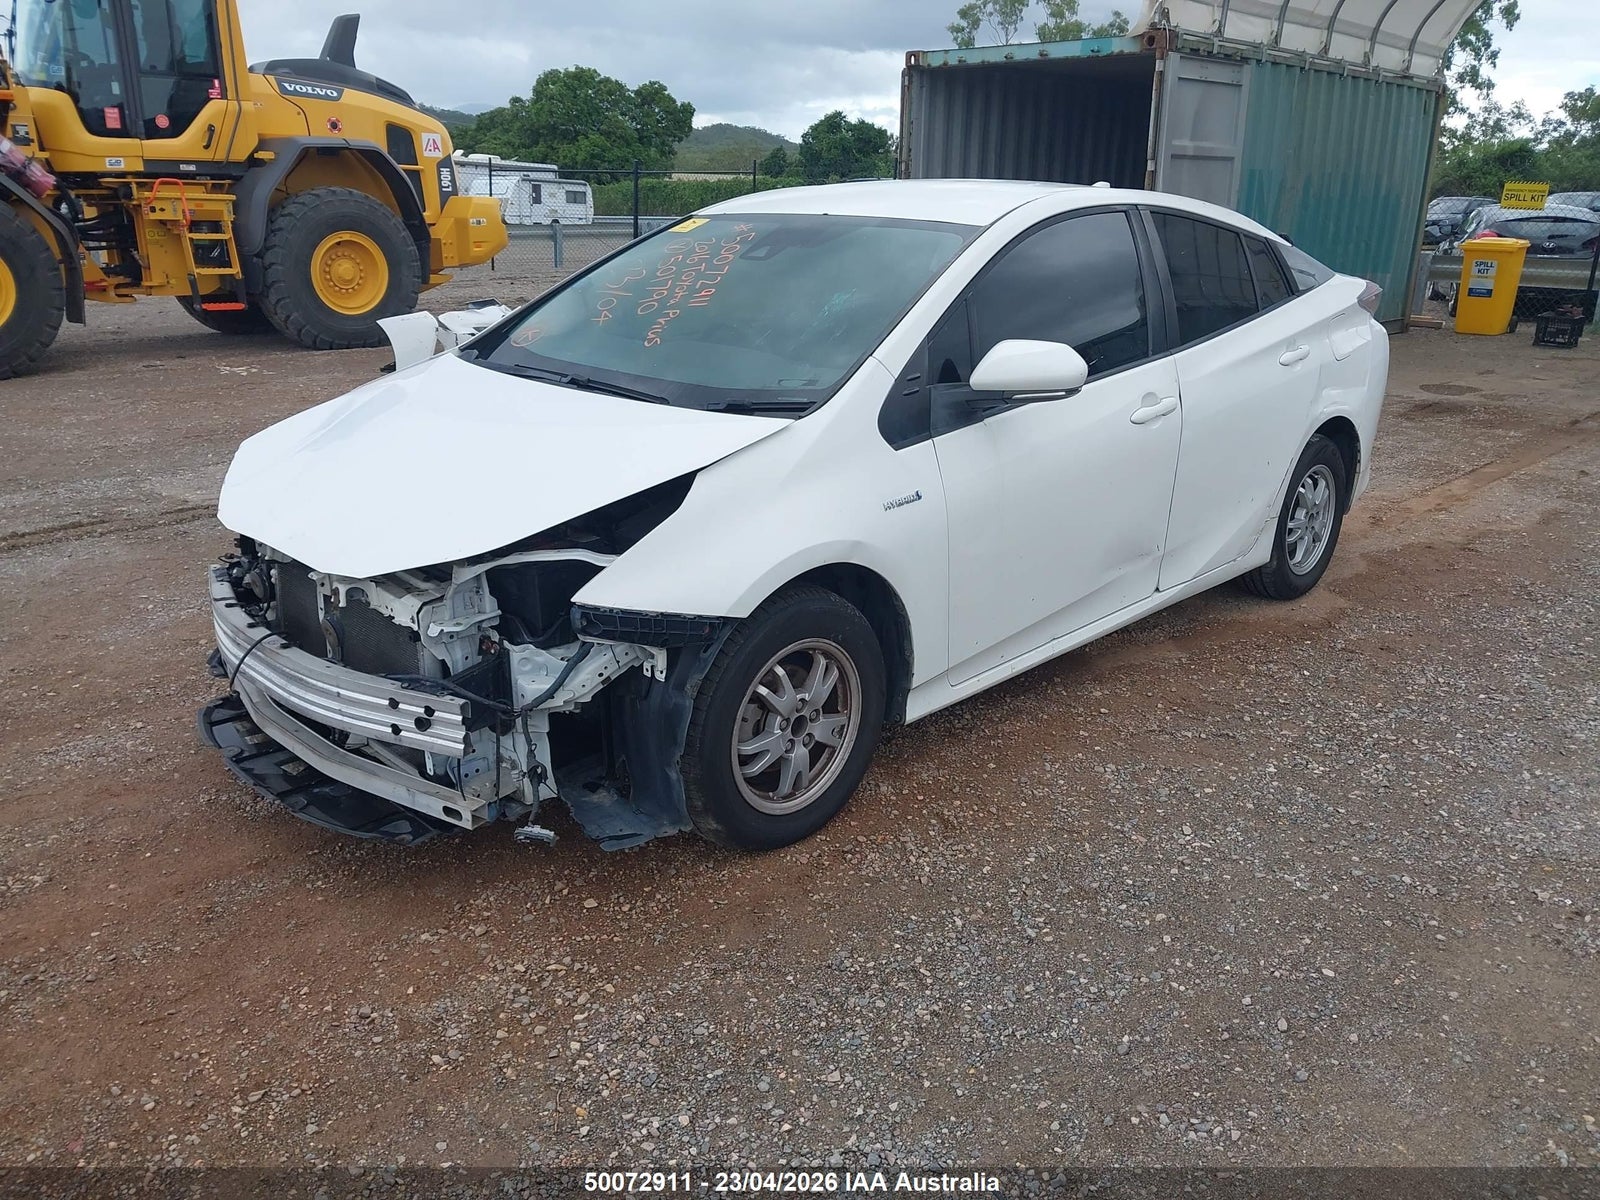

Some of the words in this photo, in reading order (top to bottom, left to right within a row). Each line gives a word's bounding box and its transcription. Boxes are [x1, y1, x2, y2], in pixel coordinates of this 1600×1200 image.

[281, 82, 338, 97] VOLVO
[440, 168, 452, 191] L90H
[1503, 193, 1527, 201] SPILL
[1530, 194, 1546, 202] KIT
[1474, 260, 1495, 269] SPILL
